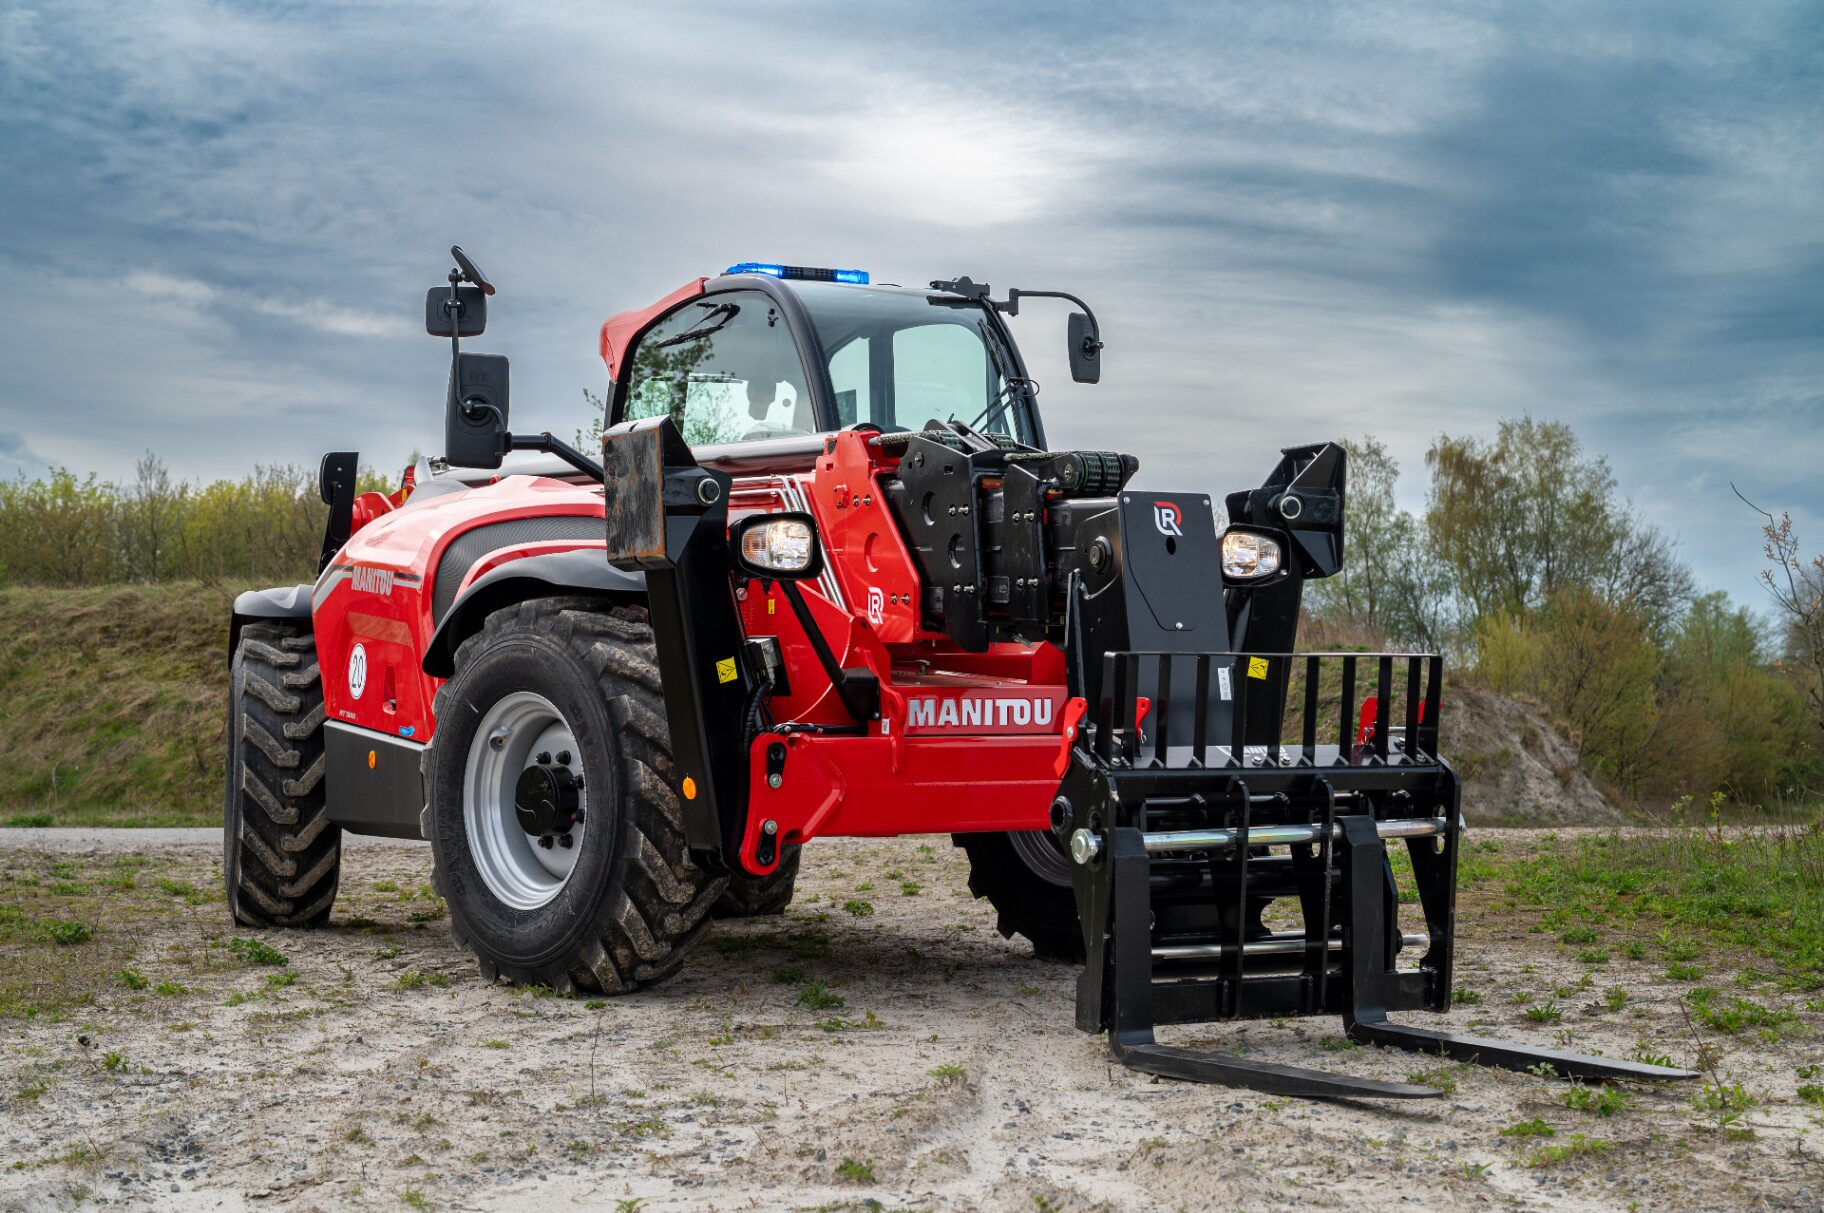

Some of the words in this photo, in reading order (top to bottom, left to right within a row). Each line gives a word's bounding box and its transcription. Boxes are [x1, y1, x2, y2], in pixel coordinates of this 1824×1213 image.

[351, 566, 395, 596] MANITOU
[352, 654, 364, 689] 20
[908, 698, 1053, 727] MANITOU
